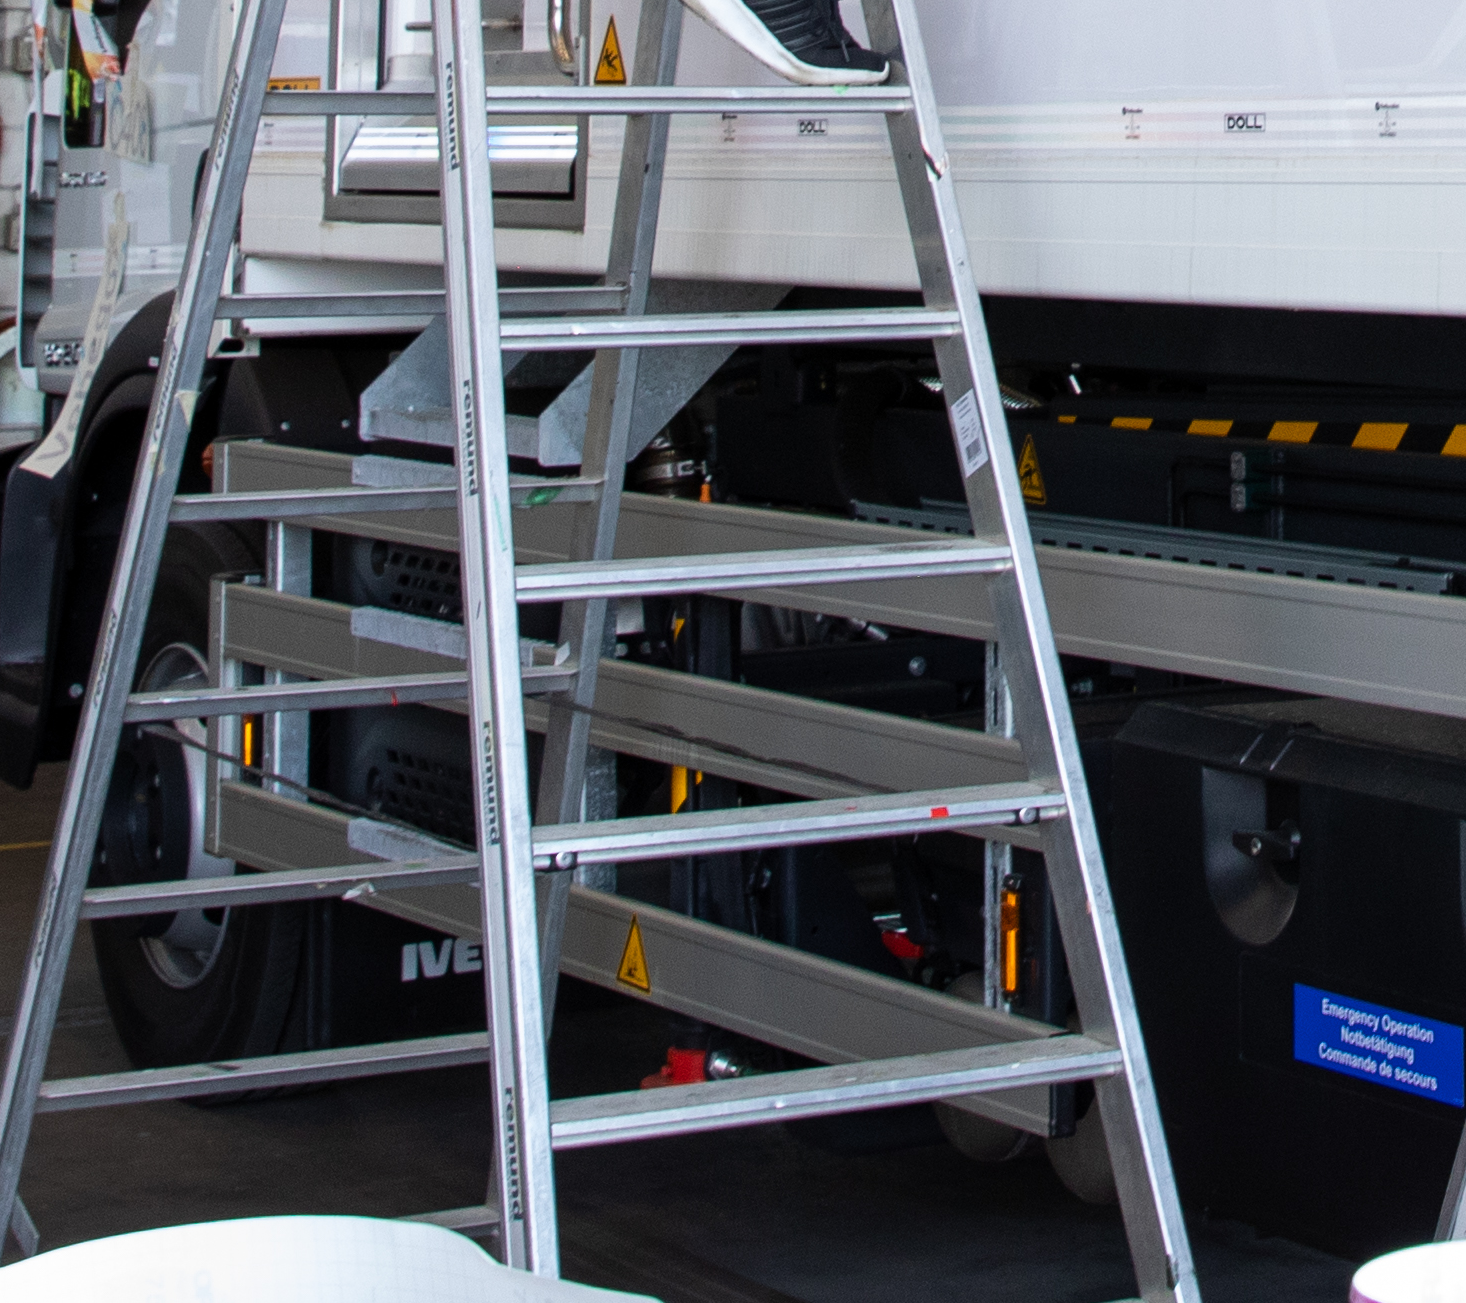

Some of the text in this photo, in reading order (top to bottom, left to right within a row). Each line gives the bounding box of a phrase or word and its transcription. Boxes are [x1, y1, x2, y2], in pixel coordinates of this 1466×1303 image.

[445, 61, 460, 171] remund
[800, 119, 825, 133] DOLL
[1227, 115, 1262, 129] DOLL
[463, 379, 479, 497] remund
[483, 720, 500, 845] remund
[402, 938, 483, 982] IVE
[1321, 997, 1434, 1044] Emergency Operation
[1318, 1042, 1438, 1091] Commande de secours
[1340, 1025, 1415, 1065] Notbetätigung
[505, 1086, 524, 1221] remund
